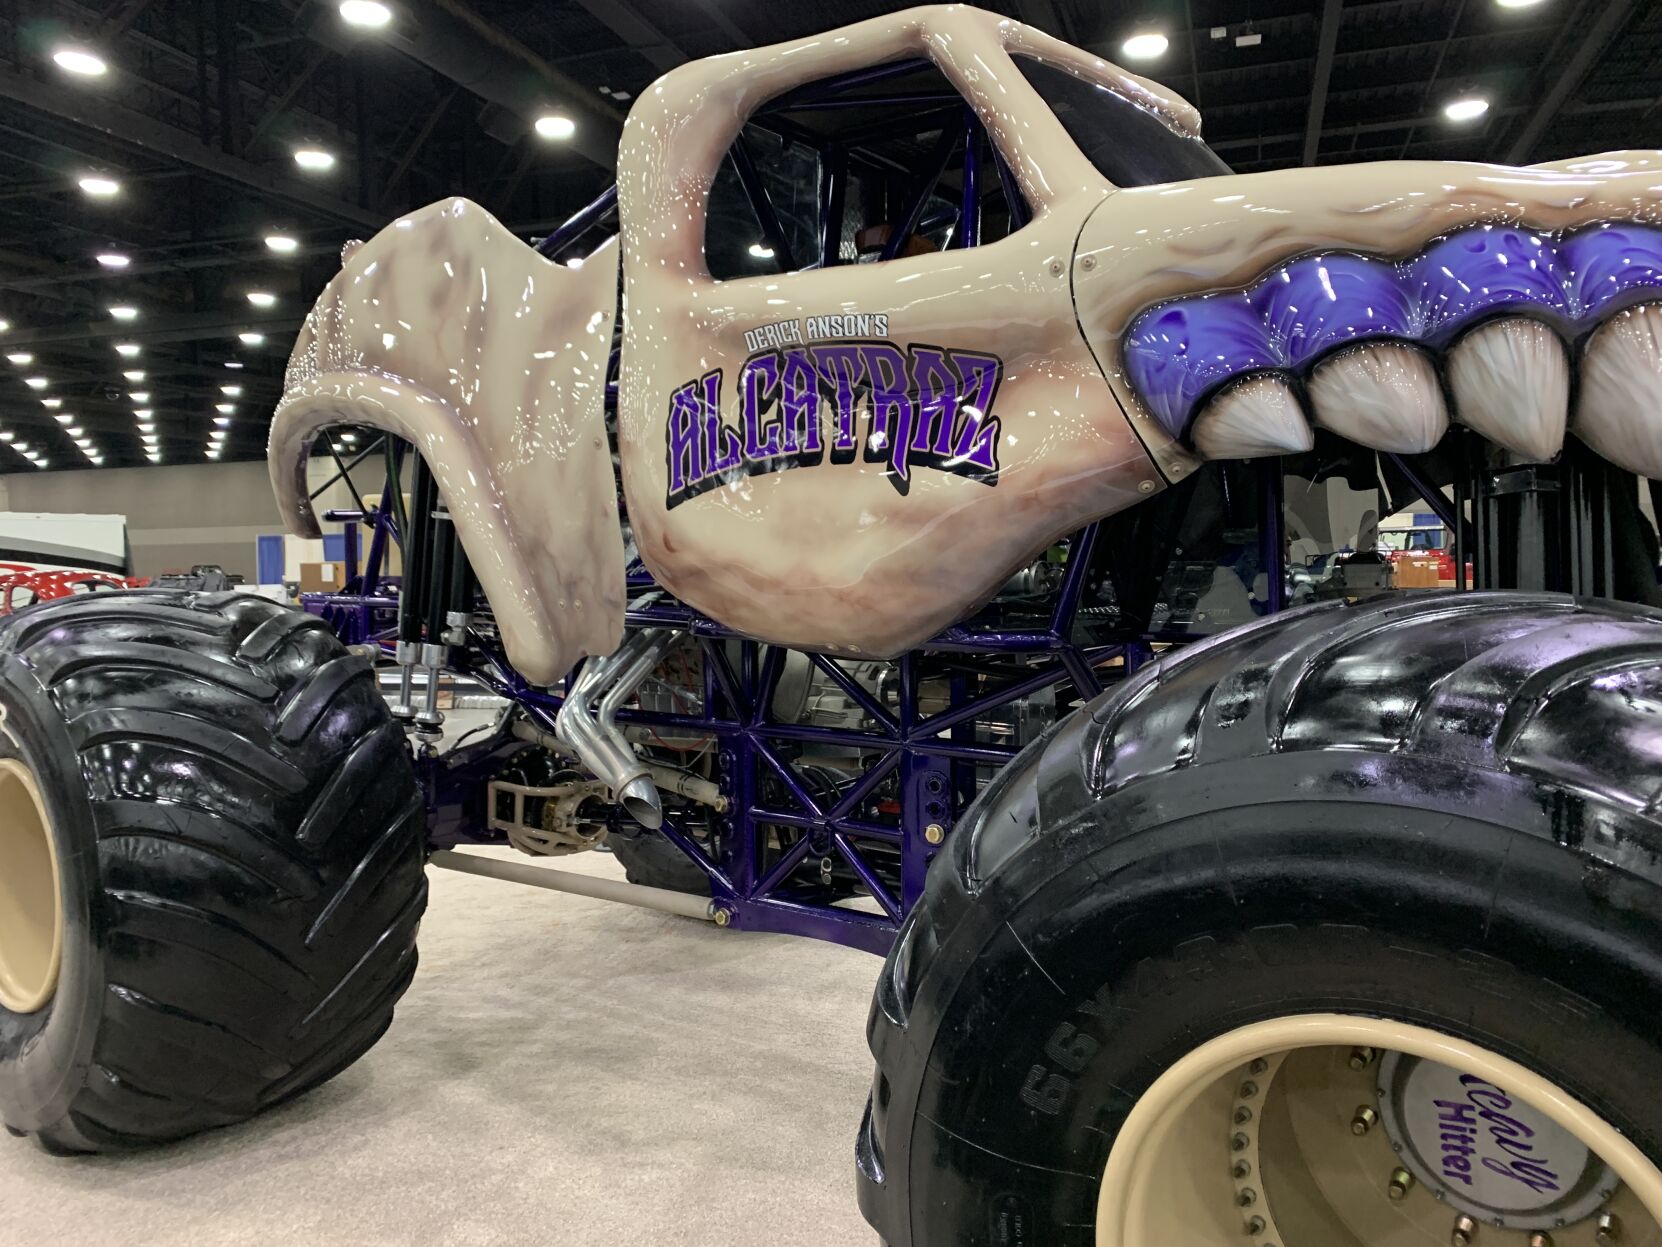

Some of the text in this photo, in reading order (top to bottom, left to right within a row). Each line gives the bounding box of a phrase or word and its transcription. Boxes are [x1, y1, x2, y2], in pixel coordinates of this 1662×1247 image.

[744, 313, 888, 352] DERICK ANSON'S
[666, 341, 1003, 508] ALCATRAZ
[1433, 1099, 1477, 1185] Hitter
